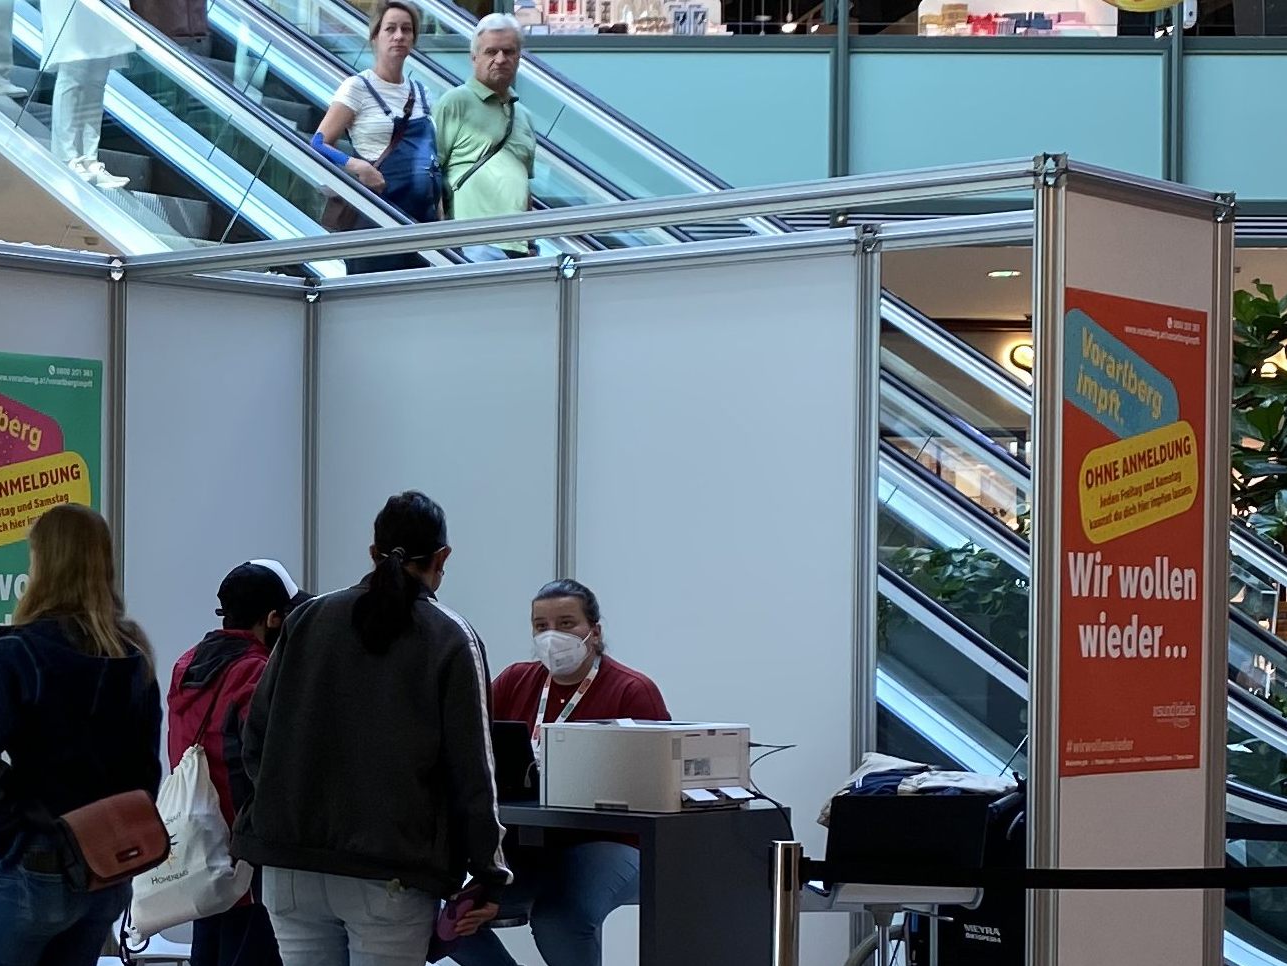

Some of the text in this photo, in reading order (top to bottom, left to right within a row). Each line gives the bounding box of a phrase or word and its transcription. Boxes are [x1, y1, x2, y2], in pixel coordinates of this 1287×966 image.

[1082, 327, 1162, 420] Vorarlberg
[1085, 435, 1191, 490] OHNE ANMELDUNG
[9, 517, 26, 529] hier
[17, 500, 33, 513] und
[33, 493, 70, 508] Samstag
[1068, 551, 1197, 600] Wir wollen
[1078, 611, 1188, 659] wieder...
